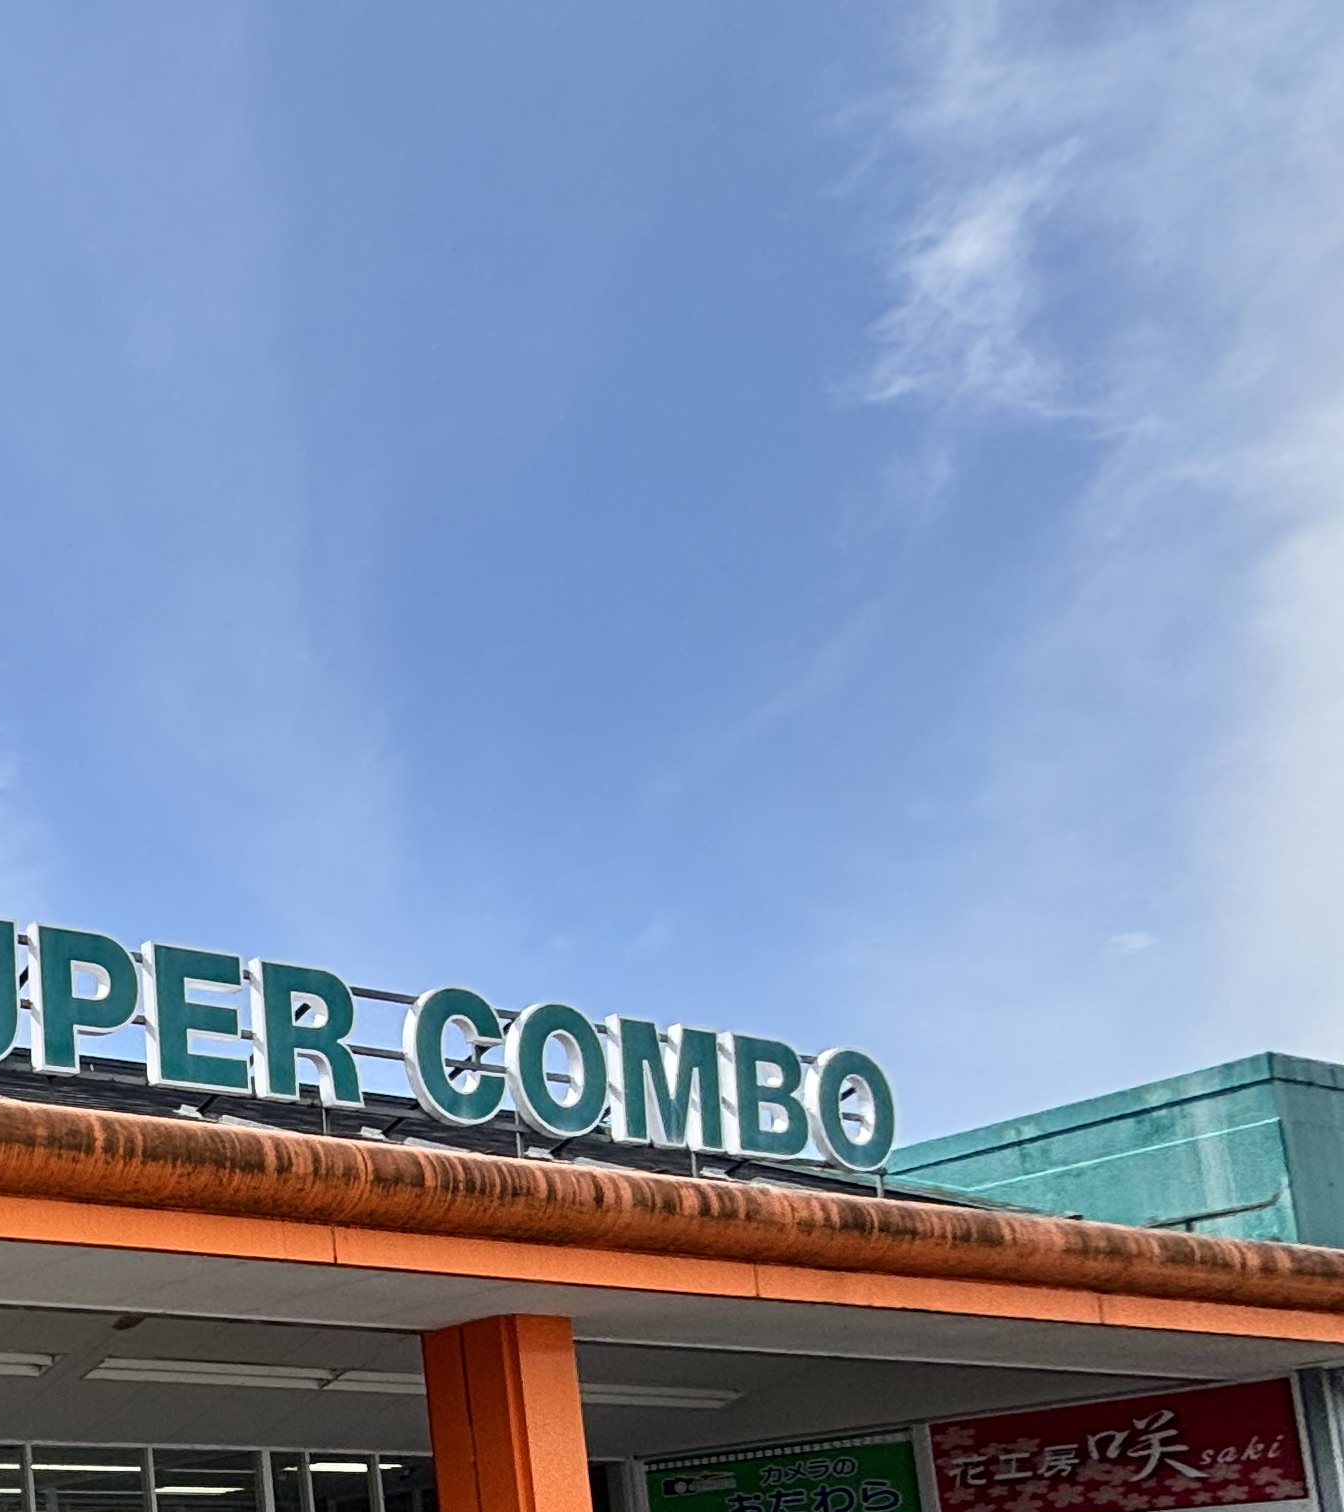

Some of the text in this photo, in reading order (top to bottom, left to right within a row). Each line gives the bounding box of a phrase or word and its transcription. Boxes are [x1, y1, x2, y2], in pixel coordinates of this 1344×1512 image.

[402, 986, 897, 1172] COMBO
[760, 1457, 857, 1486] カメラの
[949, 1409, 1210, 1486] 花工房 咲
[1198, 1433, 1285, 1466] saki
